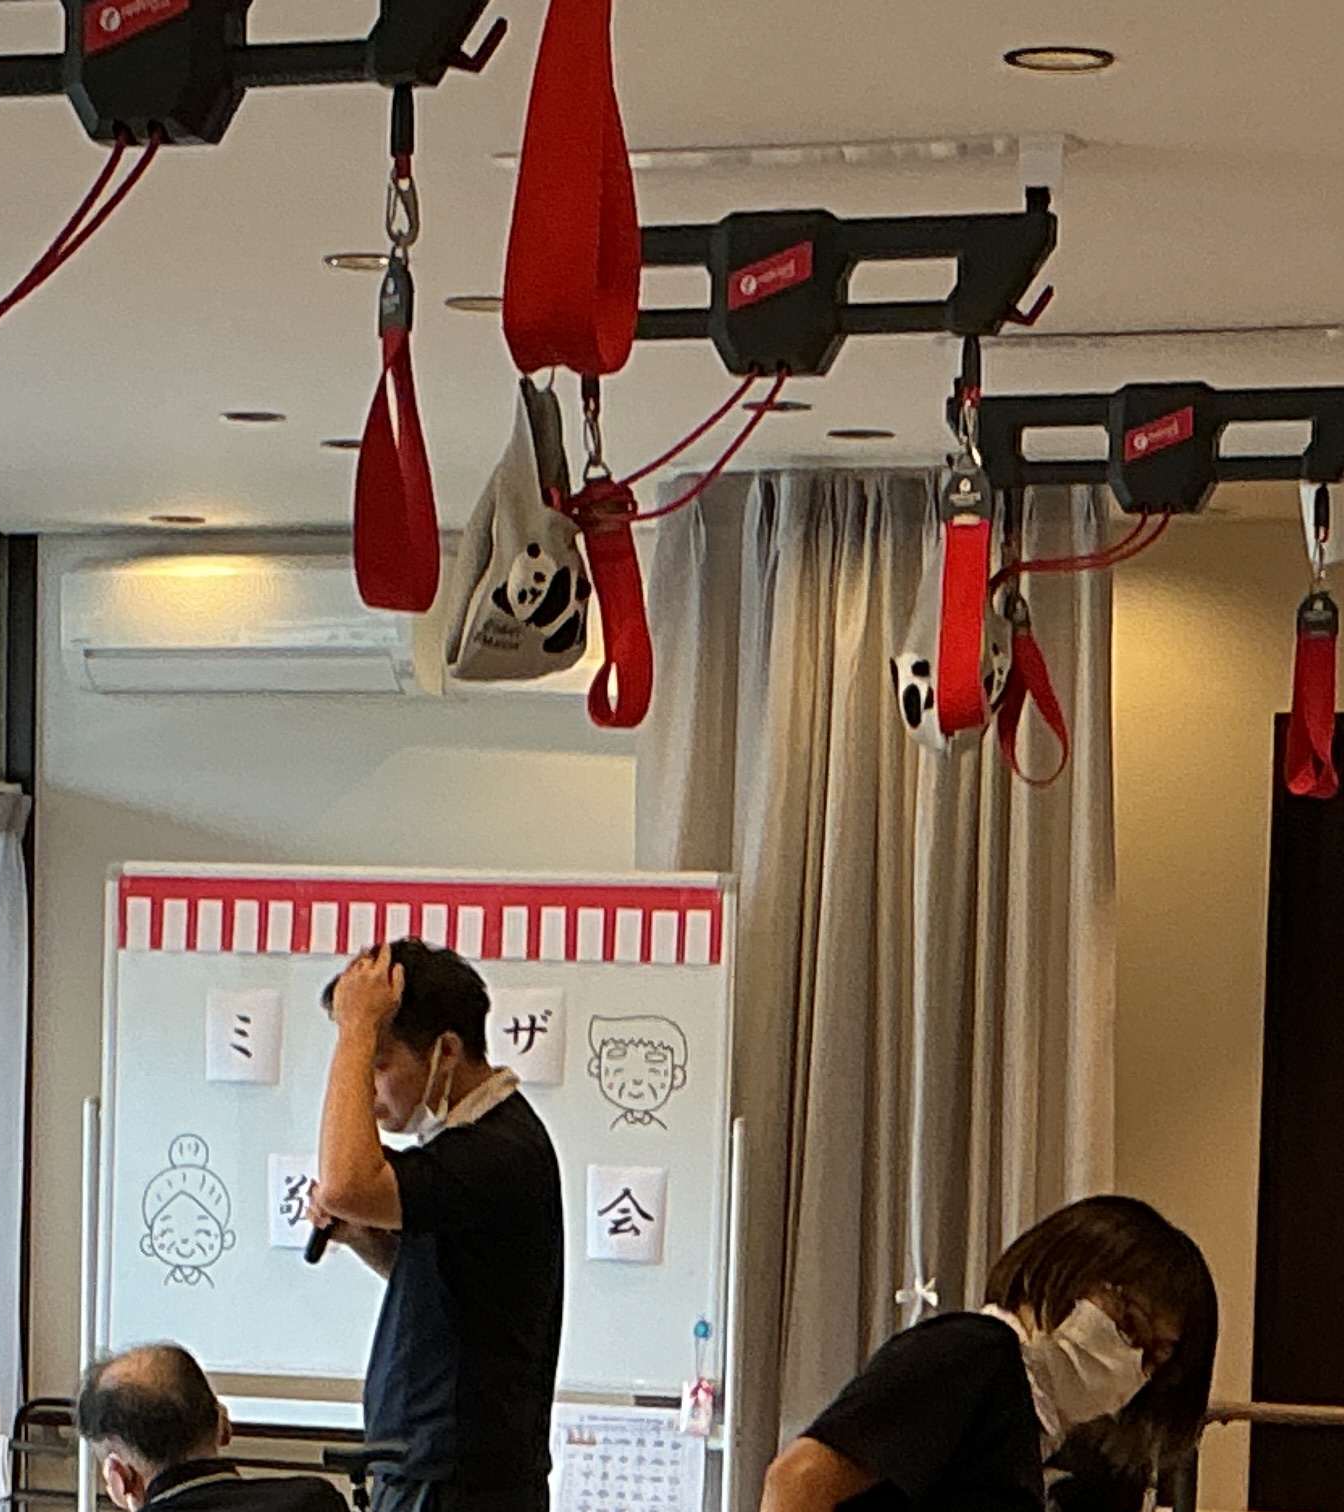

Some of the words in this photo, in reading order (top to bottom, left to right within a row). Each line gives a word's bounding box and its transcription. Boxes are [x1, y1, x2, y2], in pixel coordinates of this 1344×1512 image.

[229, 1013, 254, 1059] ミ
[502, 1008, 554, 1056] ザ
[597, 1187, 655, 1237] 会
